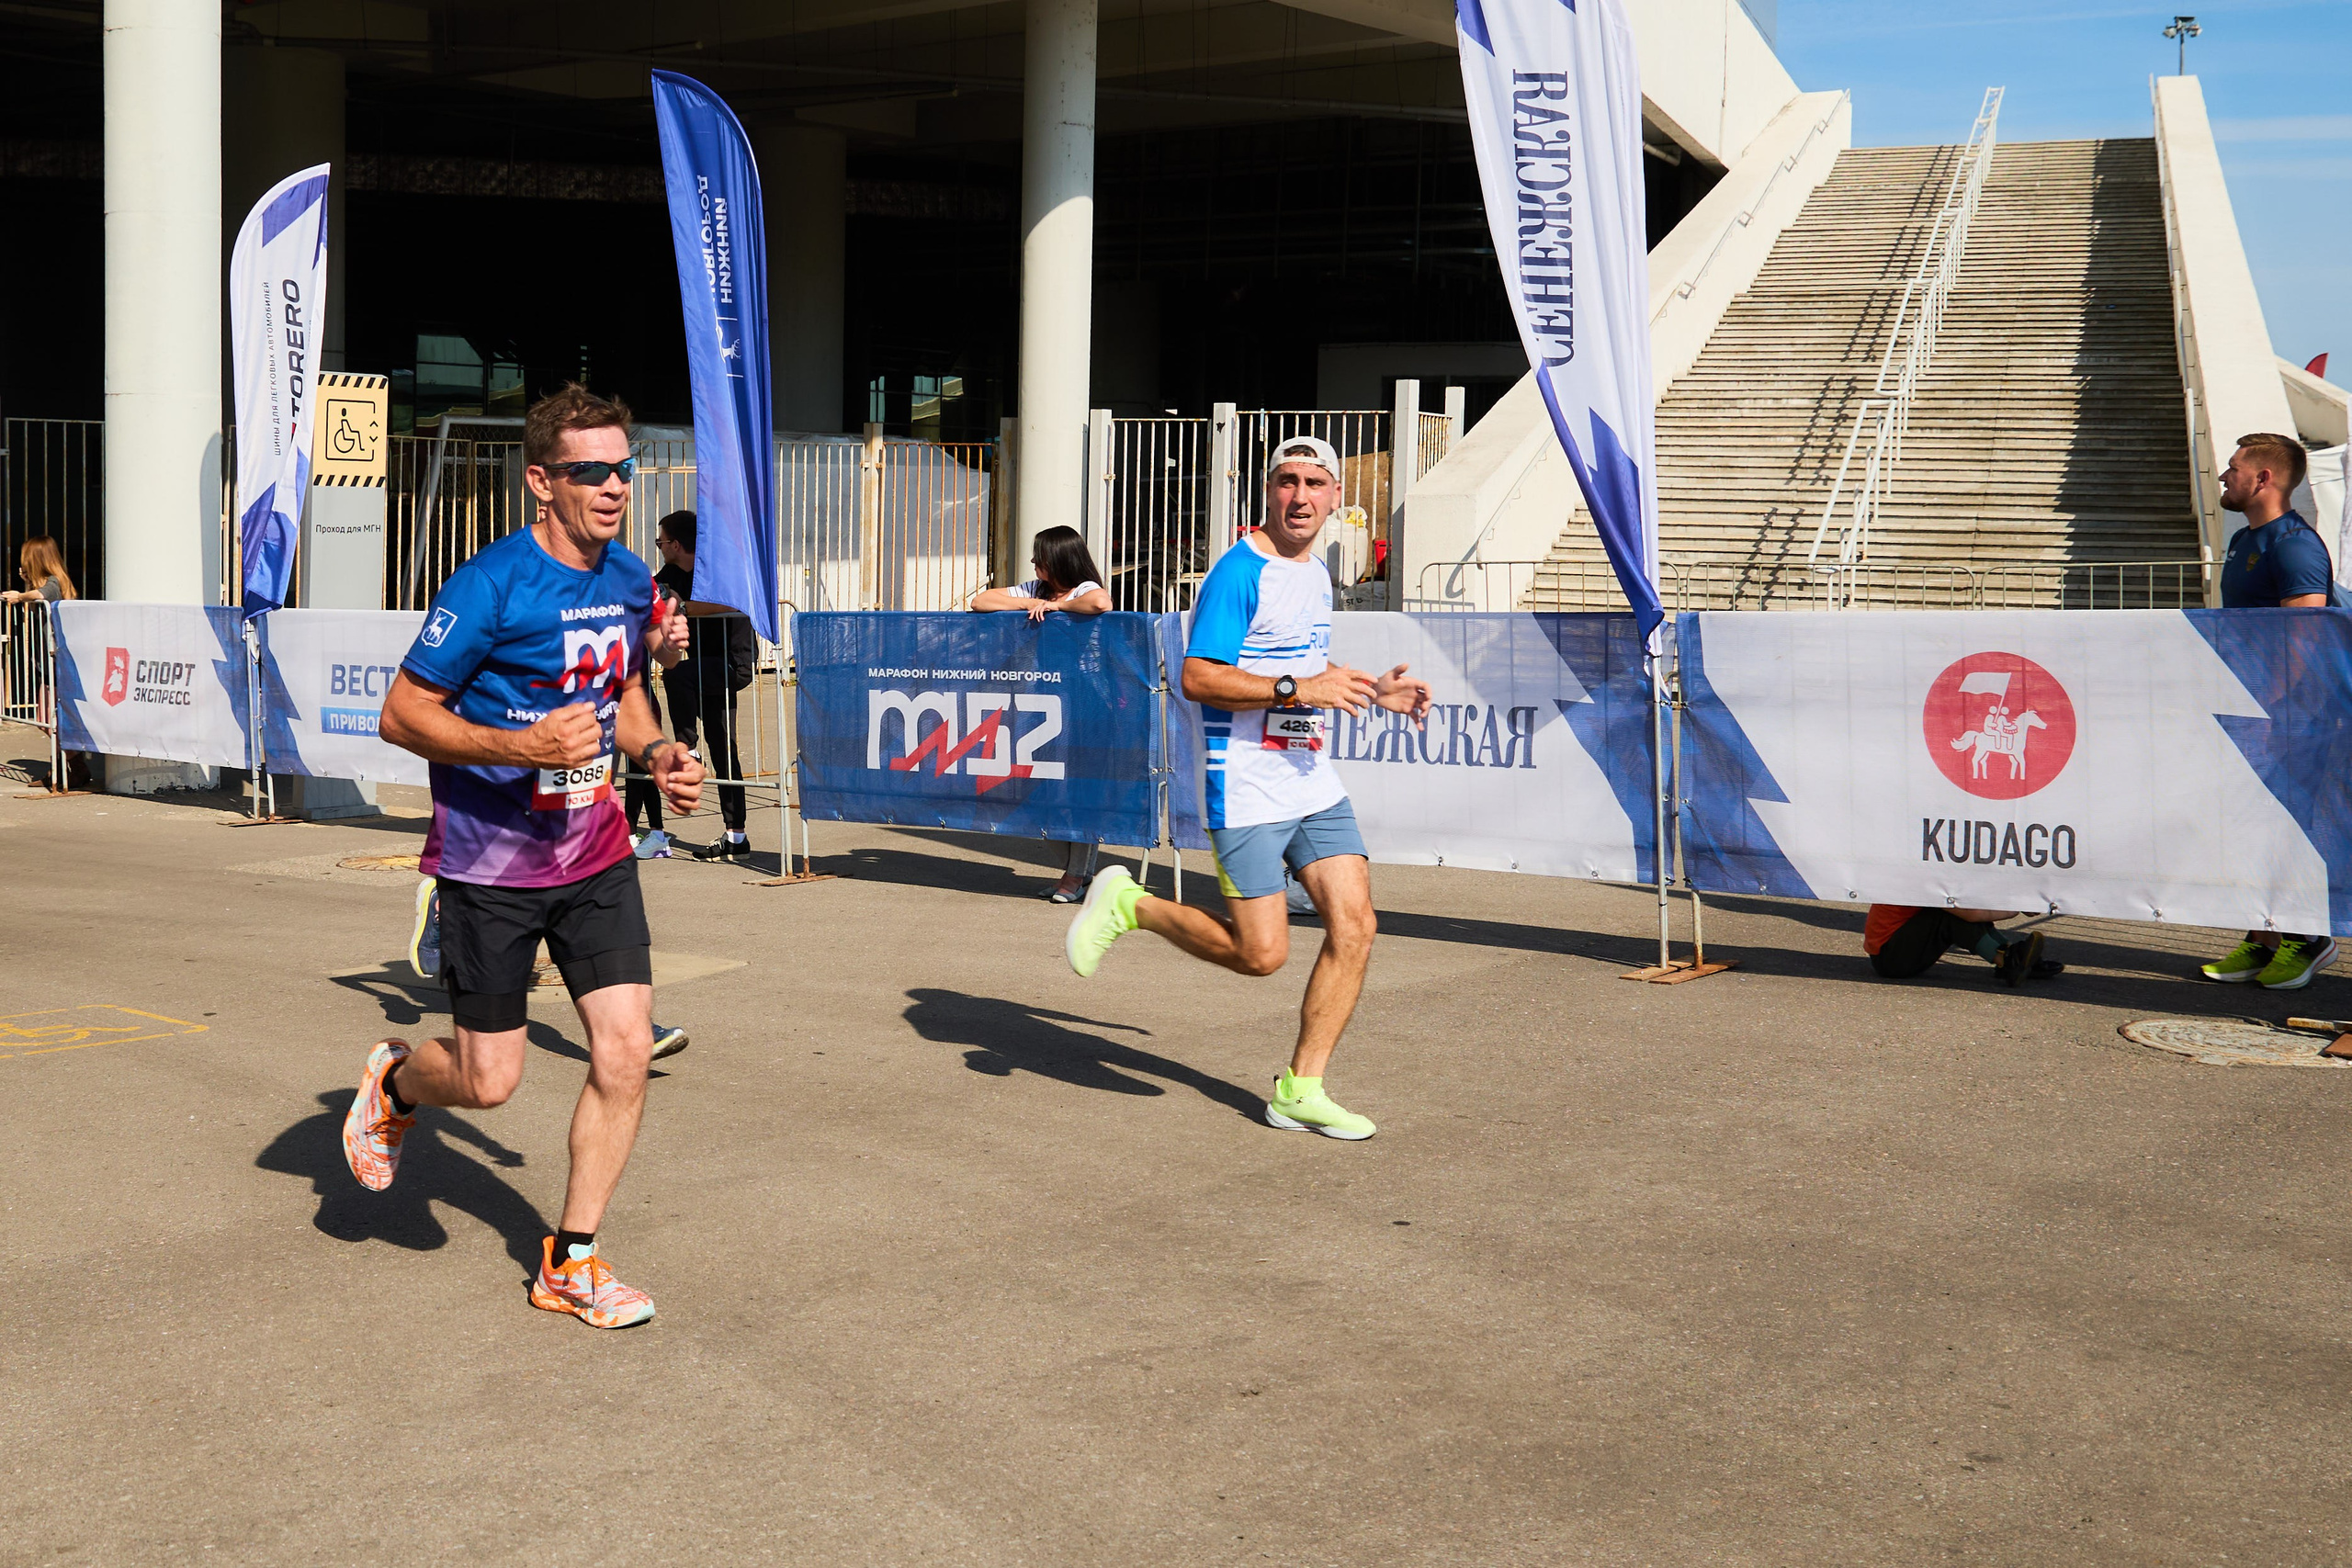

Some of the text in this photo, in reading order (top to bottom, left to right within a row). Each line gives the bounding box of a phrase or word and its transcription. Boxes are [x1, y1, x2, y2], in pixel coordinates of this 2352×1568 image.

[262, 281, 275, 351] АВТОМОБИЛЕЙ
[282, 278, 305, 418] TORERO
[269, 354, 278, 402] ЛЕГКОВЫХ
[272, 405, 280, 424] ДЛЯ
[315, 524, 345, 534] Проход
[363, 525, 381, 533] МГН
[560, 604, 625, 622] МАРАФОН
[136, 660, 196, 687] СПОРТ
[868, 667, 1062, 683] МАРАФОН НИЖНИЙ НОВГОРОД
[133, 687, 191, 705] ЭКСПРЕСС
[1325, 703, 1539, 770] НЕЖСКАЯ
[552, 764, 605, 787] 3088
[567, 797, 579, 806] 10
[1922, 818, 2076, 870] KUDAGO
